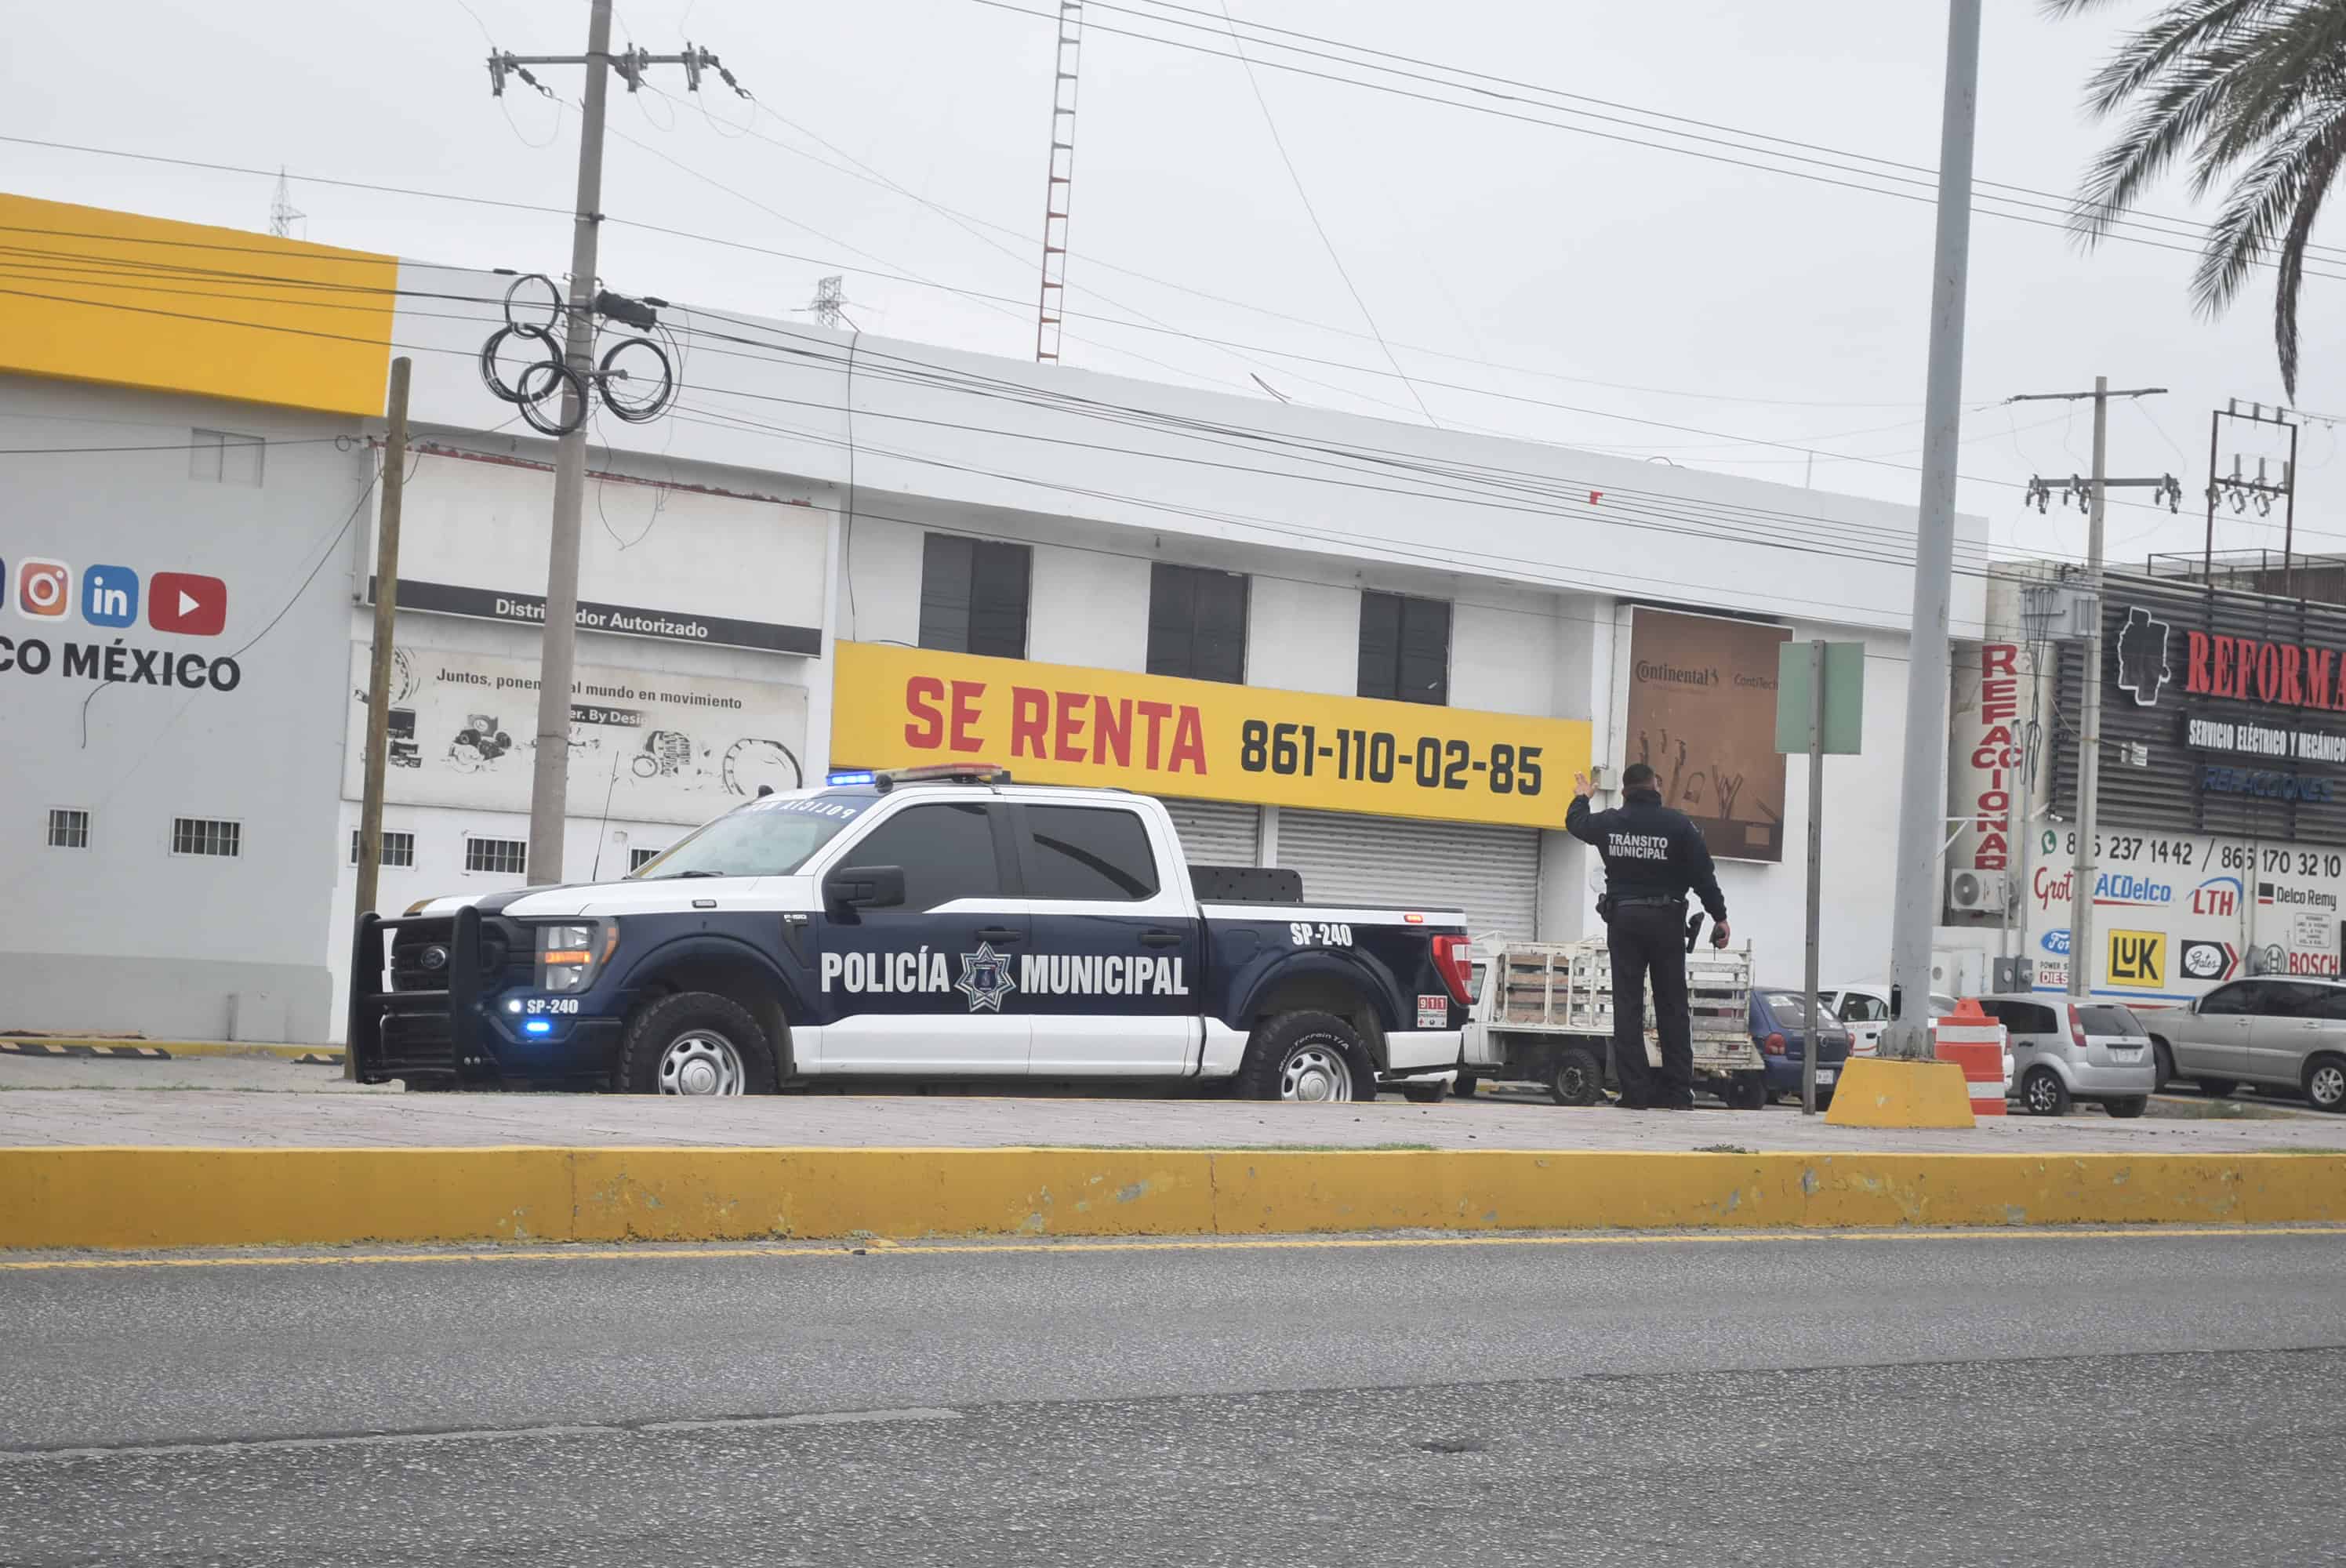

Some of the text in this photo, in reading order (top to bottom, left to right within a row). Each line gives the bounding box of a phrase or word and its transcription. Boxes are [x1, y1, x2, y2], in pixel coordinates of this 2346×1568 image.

[496, 598, 709, 638] Distridor Autorizado
[63, 638, 241, 691] MÉXICO
[1636, 660, 1709, 686] Continental
[437, 668, 492, 686] Juntos,
[586, 684, 634, 699] mundo
[639, 691, 656, 701] en
[660, 691, 742, 709] movimiento
[590, 710, 607, 723] By
[903, 676, 1542, 797] SE RENTA 861-110-02-85
[2189, 719, 2346, 762] SERVICIO ELÉCTRICO Y MECÁNICO
[1608, 832, 1669, 849] TRÁNSITO
[1608, 844, 1669, 860] MUNICIPAL
[2109, 836, 2142, 861] 237
[2263, 849, 2290, 873] 170
[2034, 866, 2073, 910] Grot
[2094, 873, 2172, 902] ACDelco
[2277, 887, 2337, 911] Delco Remy
[2193, 888, 2234, 916] LTH
[1290, 922, 1353, 947] SP-240
[820, 946, 1189, 996] POLICÍA MUNICIPAL
[2041, 971, 2068, 984] DIES
[2290, 952, 2338, 975] BOSCH
[526, 999, 579, 1014] SP-240
